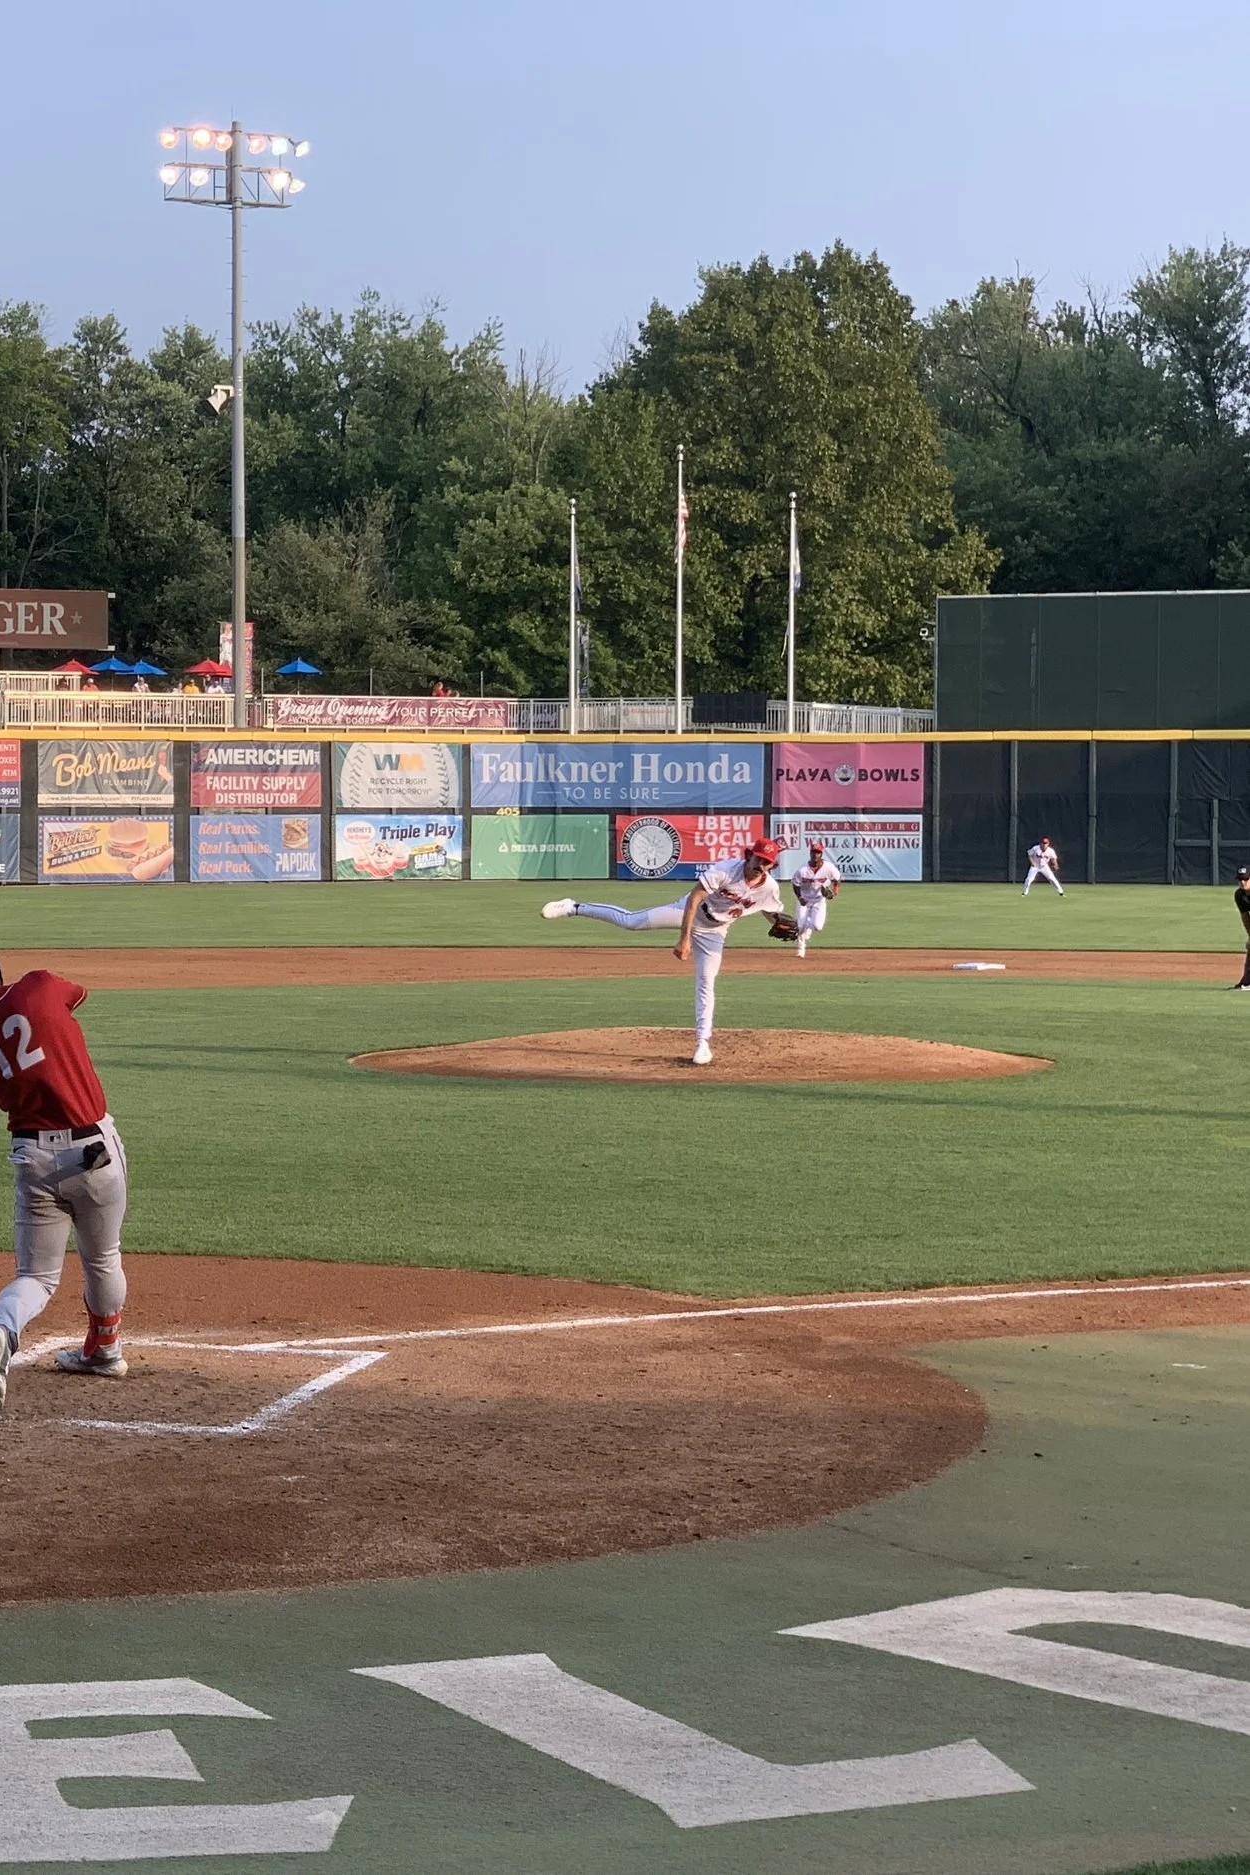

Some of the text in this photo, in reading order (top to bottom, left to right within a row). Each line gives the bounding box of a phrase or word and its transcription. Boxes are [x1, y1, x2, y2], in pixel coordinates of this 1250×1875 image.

[277, 698, 390, 722] Grand Opening
[395, 707, 505, 718] YOUR PERFECT FIT
[205, 748, 314, 765] AMERICHEM
[373, 753, 426, 772] WM
[53, 751, 156, 787] Bob Means
[480, 753, 752, 784] Faulkner Honda
[775, 769, 831, 782] PLAYA
[858, 769, 920, 782] BOWLS
[103, 779, 150, 787] PLUMBING
[206, 776, 307, 790] FACILITY SUPPLY
[215, 793, 298, 804] DISTRIBUTOR
[385, 788, 430, 796] TOMORROW
[563, 787, 660, 800] TO BE SURE
[496, 808, 520, 816] 405
[198, 822, 260, 835] Real Farms.
[698, 816, 750, 830] IBEW
[807, 822, 919, 832] HARRISBURG
[379, 823, 456, 841] Triple Play
[695, 832, 756, 846] LOCAL
[805, 838, 920, 849] WALL & FLOORING
[198, 842, 272, 855] Real Families.
[511, 844, 575, 852] DELTA DENTAL
[708, 848, 741, 861] 143
[198, 861, 222, 874] Real
[836, 865, 873, 874] HAWK
